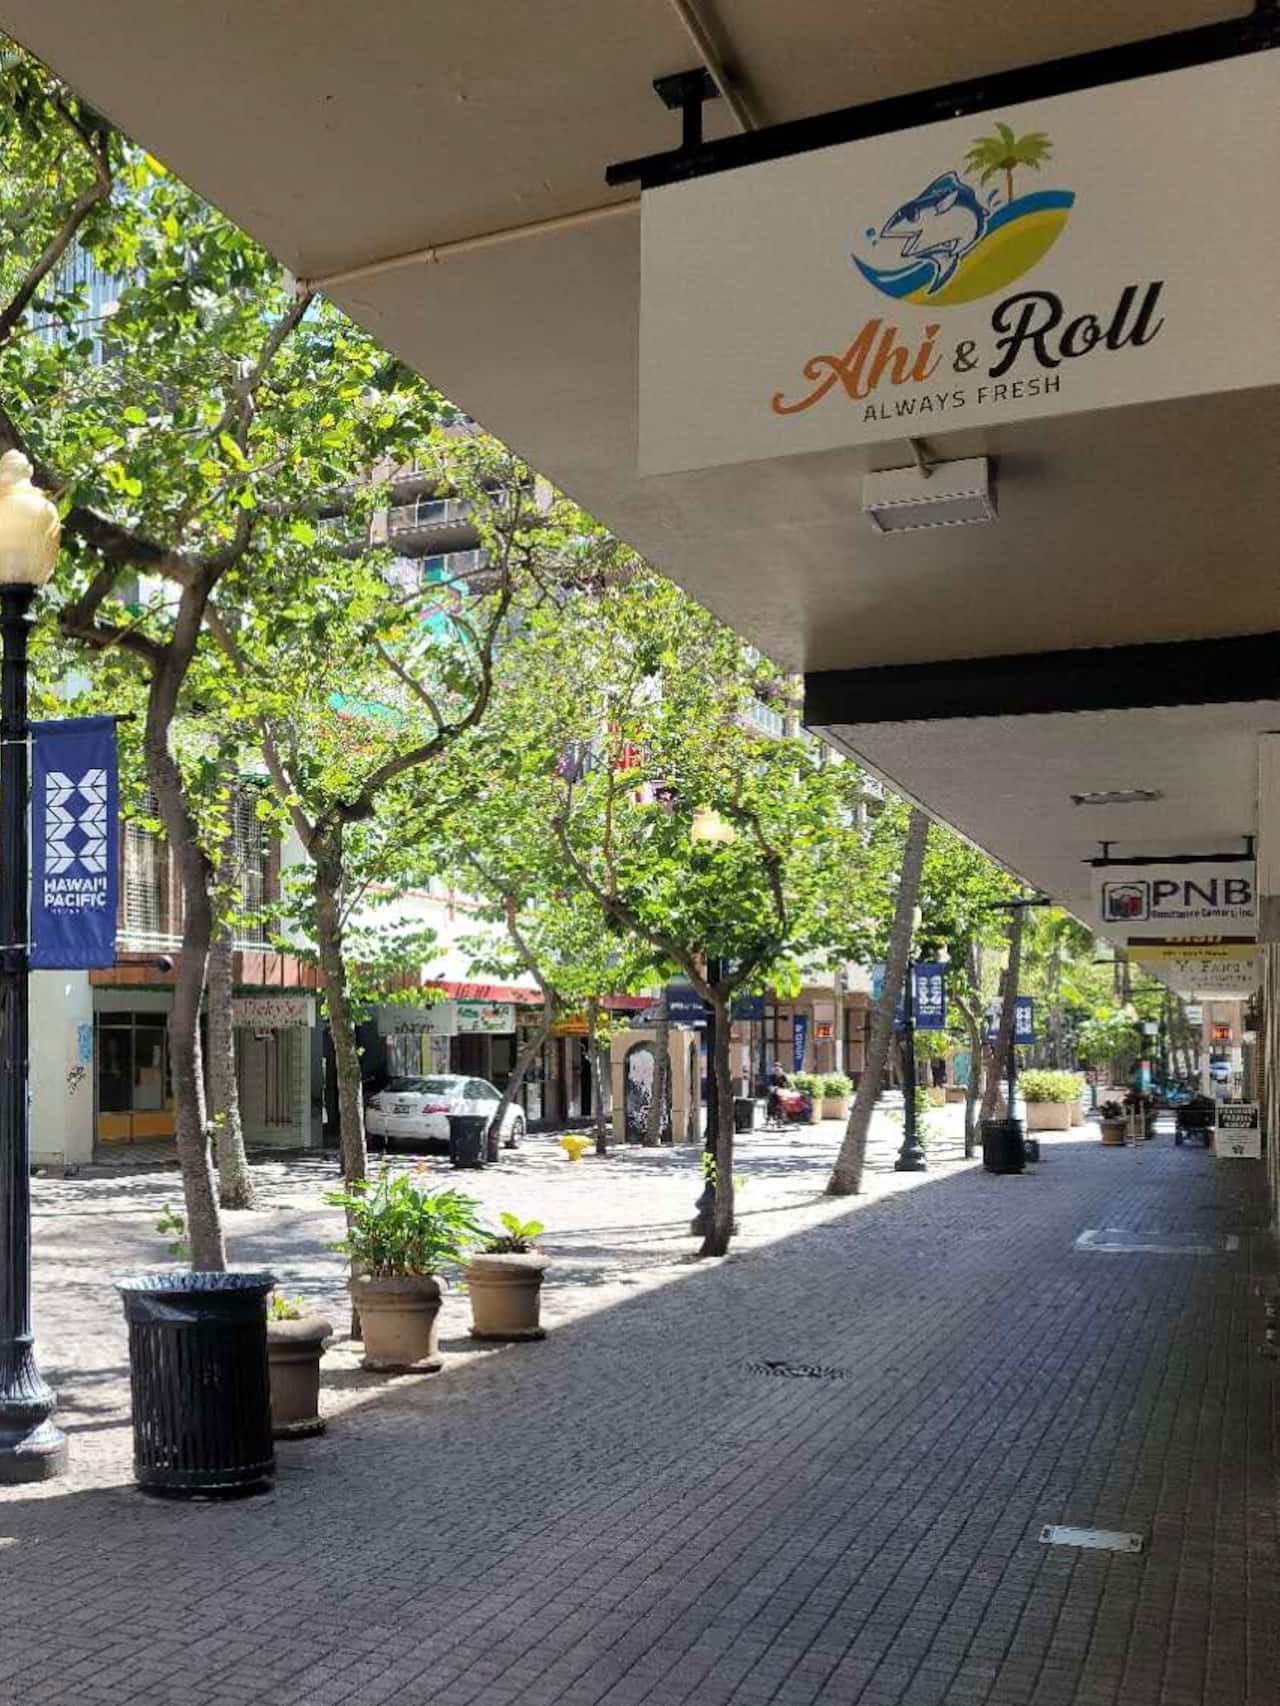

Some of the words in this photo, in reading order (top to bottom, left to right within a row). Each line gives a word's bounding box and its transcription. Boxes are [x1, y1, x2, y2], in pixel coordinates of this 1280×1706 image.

[772, 318, 942, 415] Ahi
[953, 340, 978, 371] &
[989, 281, 1164, 377] Roll
[863, 391, 966, 422] ALWAYS
[977, 375, 1060, 404] FRESH
[44, 892, 106, 907] PACIFIC
[1153, 878, 1251, 906] PNB
